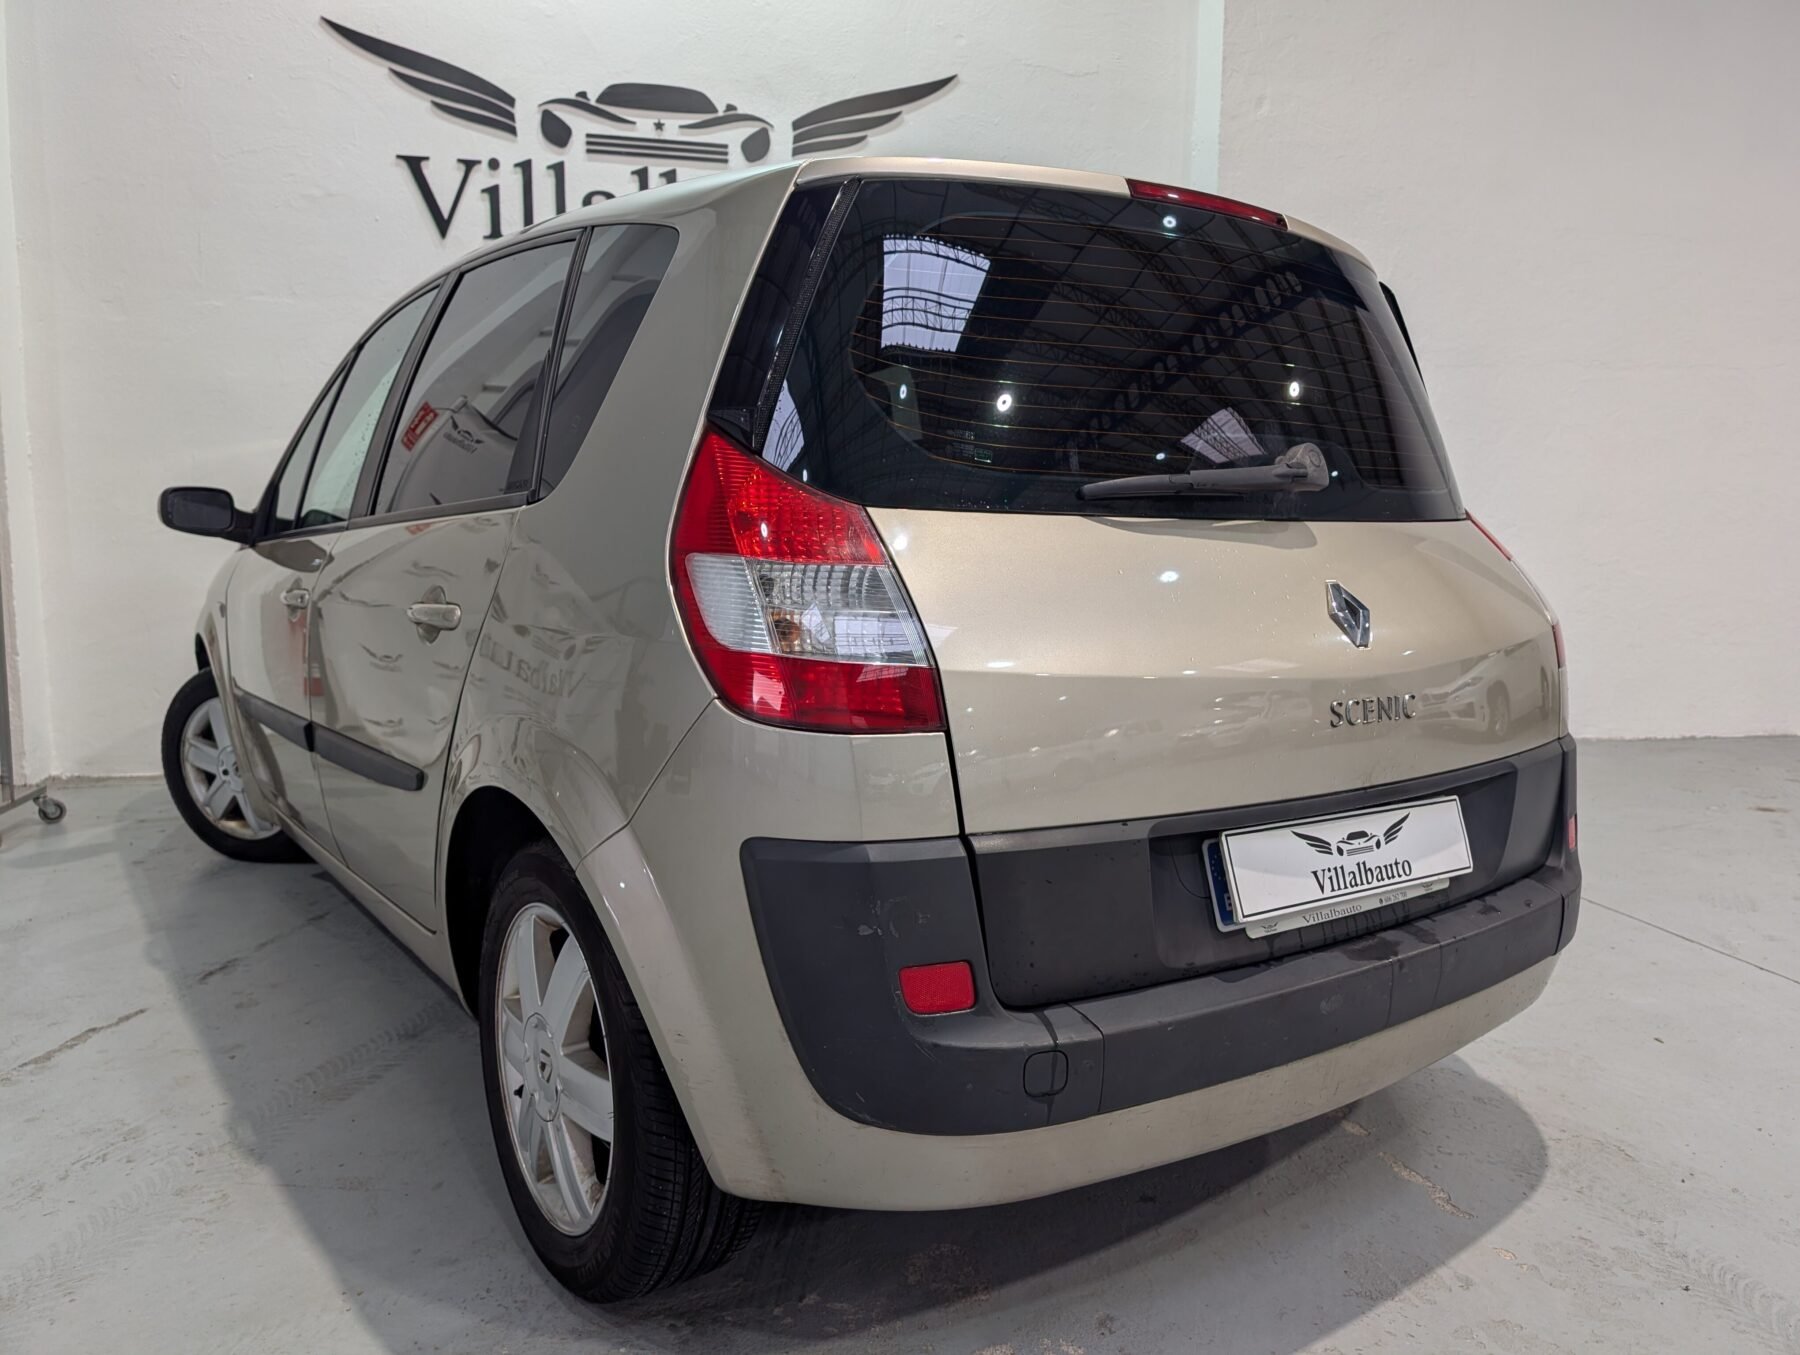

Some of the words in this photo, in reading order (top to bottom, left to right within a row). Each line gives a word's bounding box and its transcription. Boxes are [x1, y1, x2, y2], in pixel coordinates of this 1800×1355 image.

[396, 154, 677, 240] Vill
[1330, 694, 1416, 728] SCENIC
[1311, 857, 1413, 895] Villalbauto
[1302, 904, 1362, 924] Villalbauto
